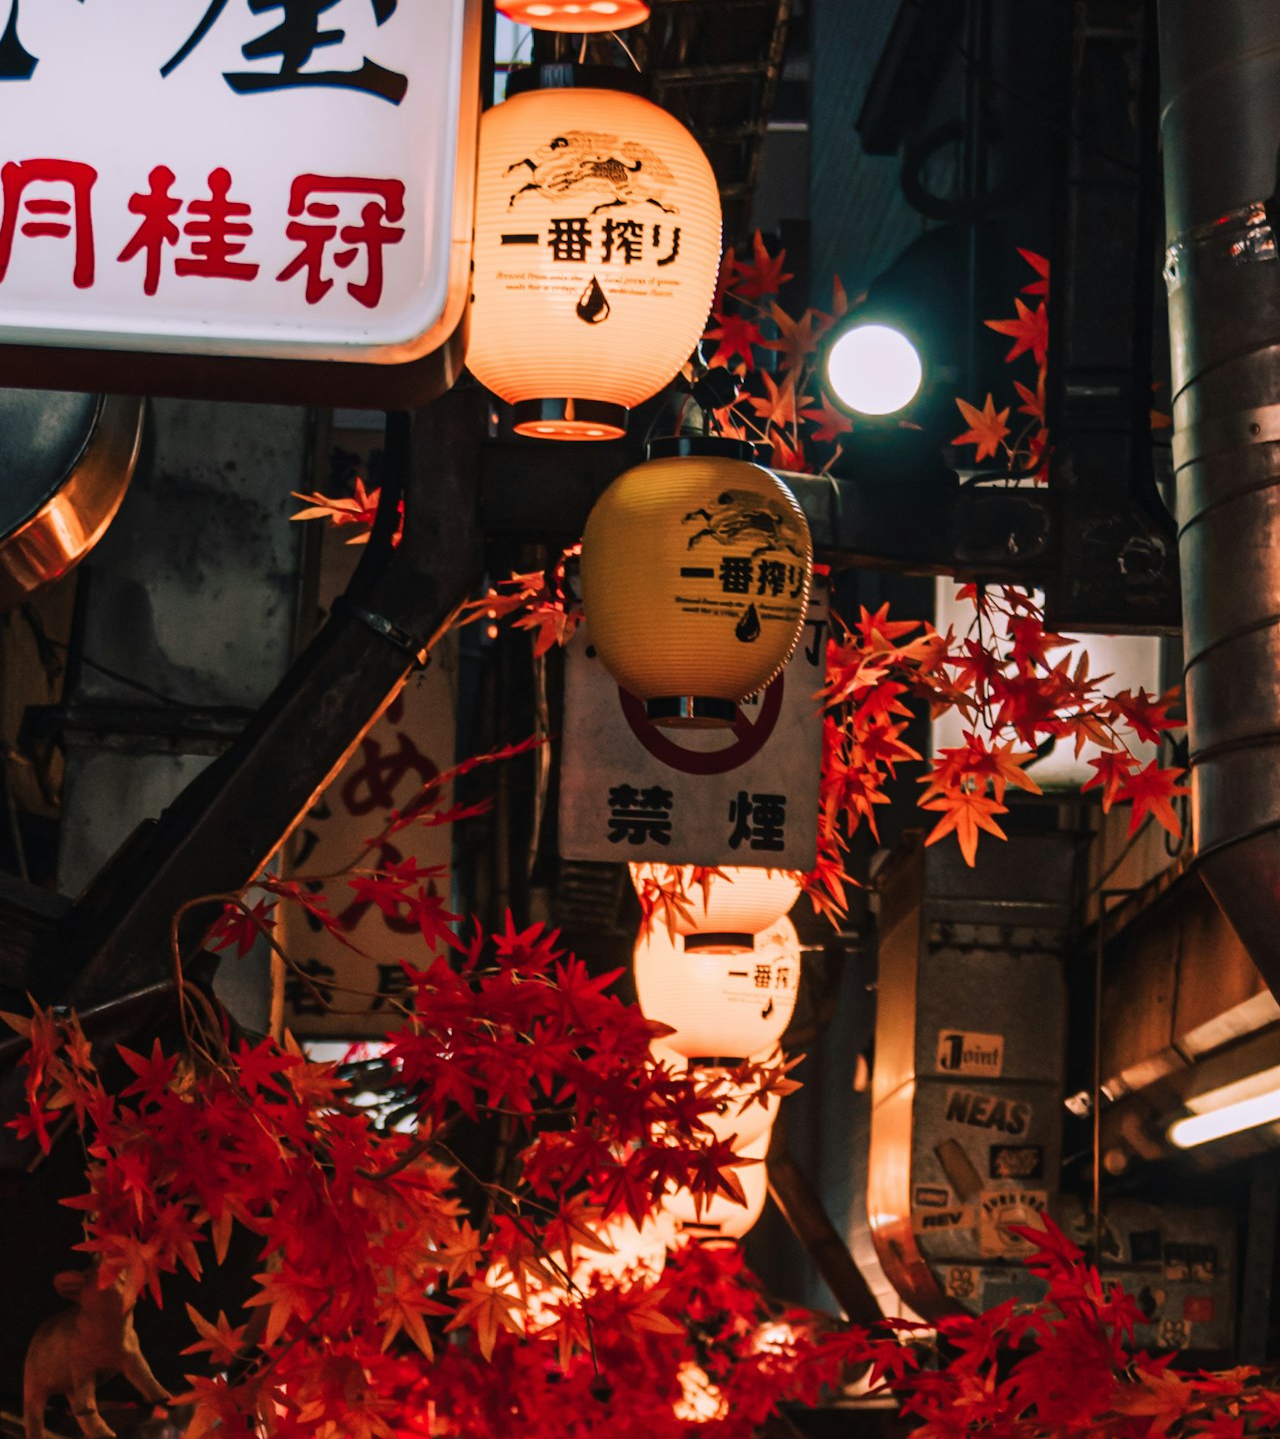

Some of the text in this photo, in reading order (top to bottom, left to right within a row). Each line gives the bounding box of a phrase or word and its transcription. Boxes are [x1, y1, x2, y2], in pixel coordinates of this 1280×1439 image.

[500, 217, 681, 267] 一番搾り
[680, 557, 805, 599] 一番搾り
[607, 784, 787, 852] 禁煙
[940, 1034, 1000, 1070] Joint
